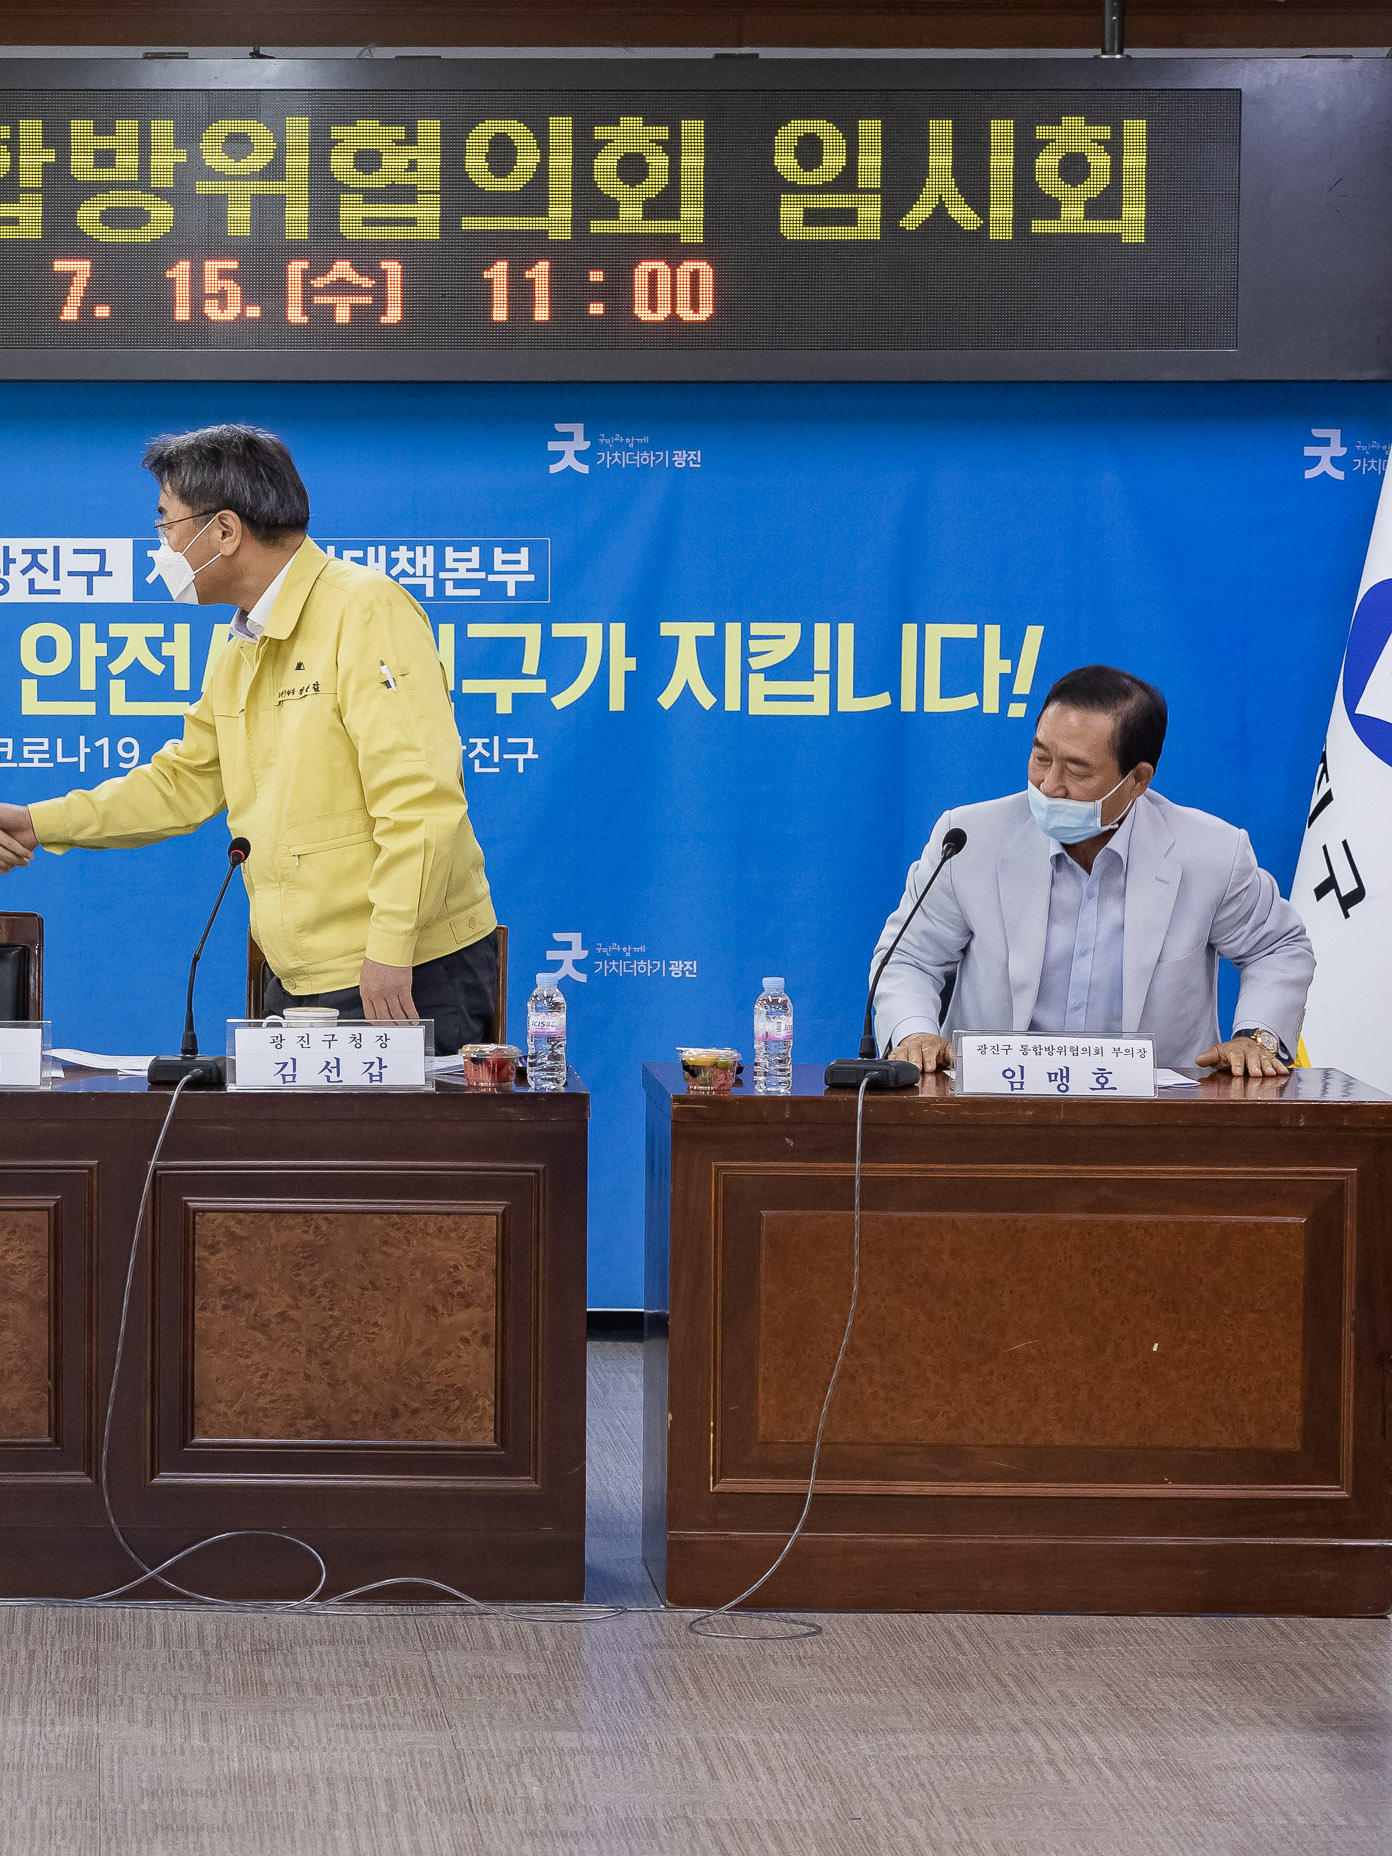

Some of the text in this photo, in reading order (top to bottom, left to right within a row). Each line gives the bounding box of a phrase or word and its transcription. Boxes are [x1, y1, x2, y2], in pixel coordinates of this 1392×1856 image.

[774, 116, 1148, 243] 임시회
[52, 259, 111, 321] 7.
[596, 450, 702, 468] 가치더하기 광진
[20, 622, 191, 716] 안전
[439, 622, 637, 716] 구가
[657, 622, 1045, 718] 지킵니다!
[460, 735, 539, 773] 진구
[594, 959, 698, 978] 가치더하기 광진
[976, 1043, 1148, 1059] 광진구 통합방위협의회 부의장
